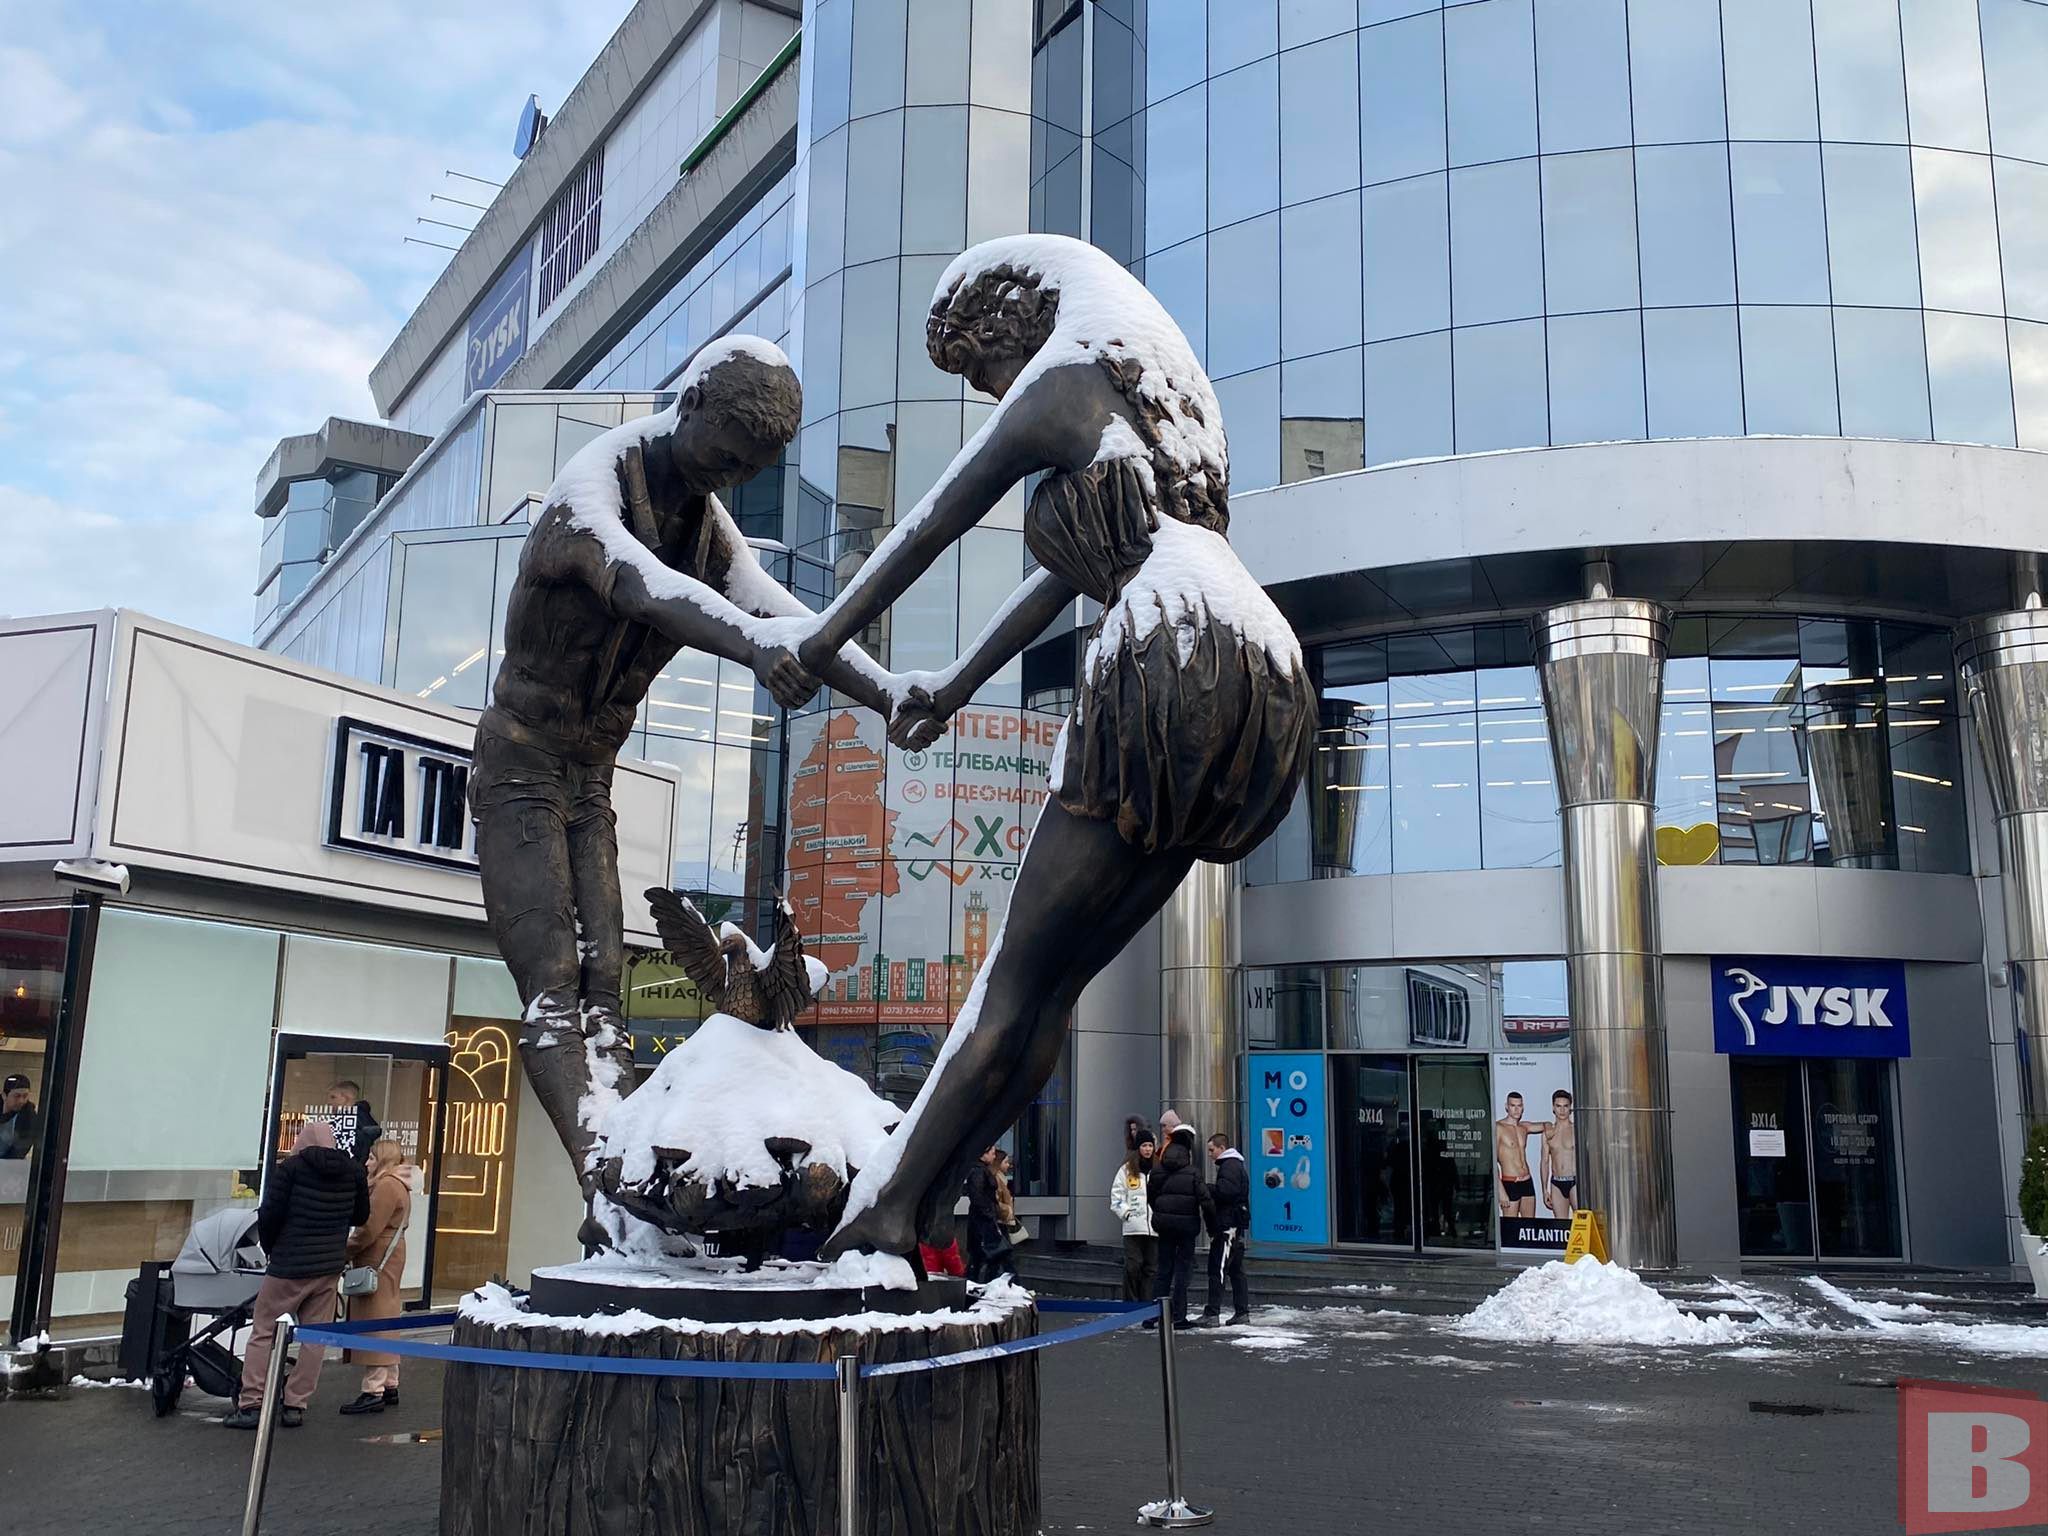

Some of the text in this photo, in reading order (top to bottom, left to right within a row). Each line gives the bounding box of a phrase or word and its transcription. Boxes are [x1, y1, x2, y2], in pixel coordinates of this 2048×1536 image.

[478, 296, 523, 381] JYSK
[947, 712, 1064, 747] НТЕРНЕ
[1761, 985, 1894, 1028] JYSK
[1359, 1108, 1384, 1125] ВХІД
[1750, 1113, 1777, 1130] ВХІД
[1283, 1201, 1291, 1220] 1
